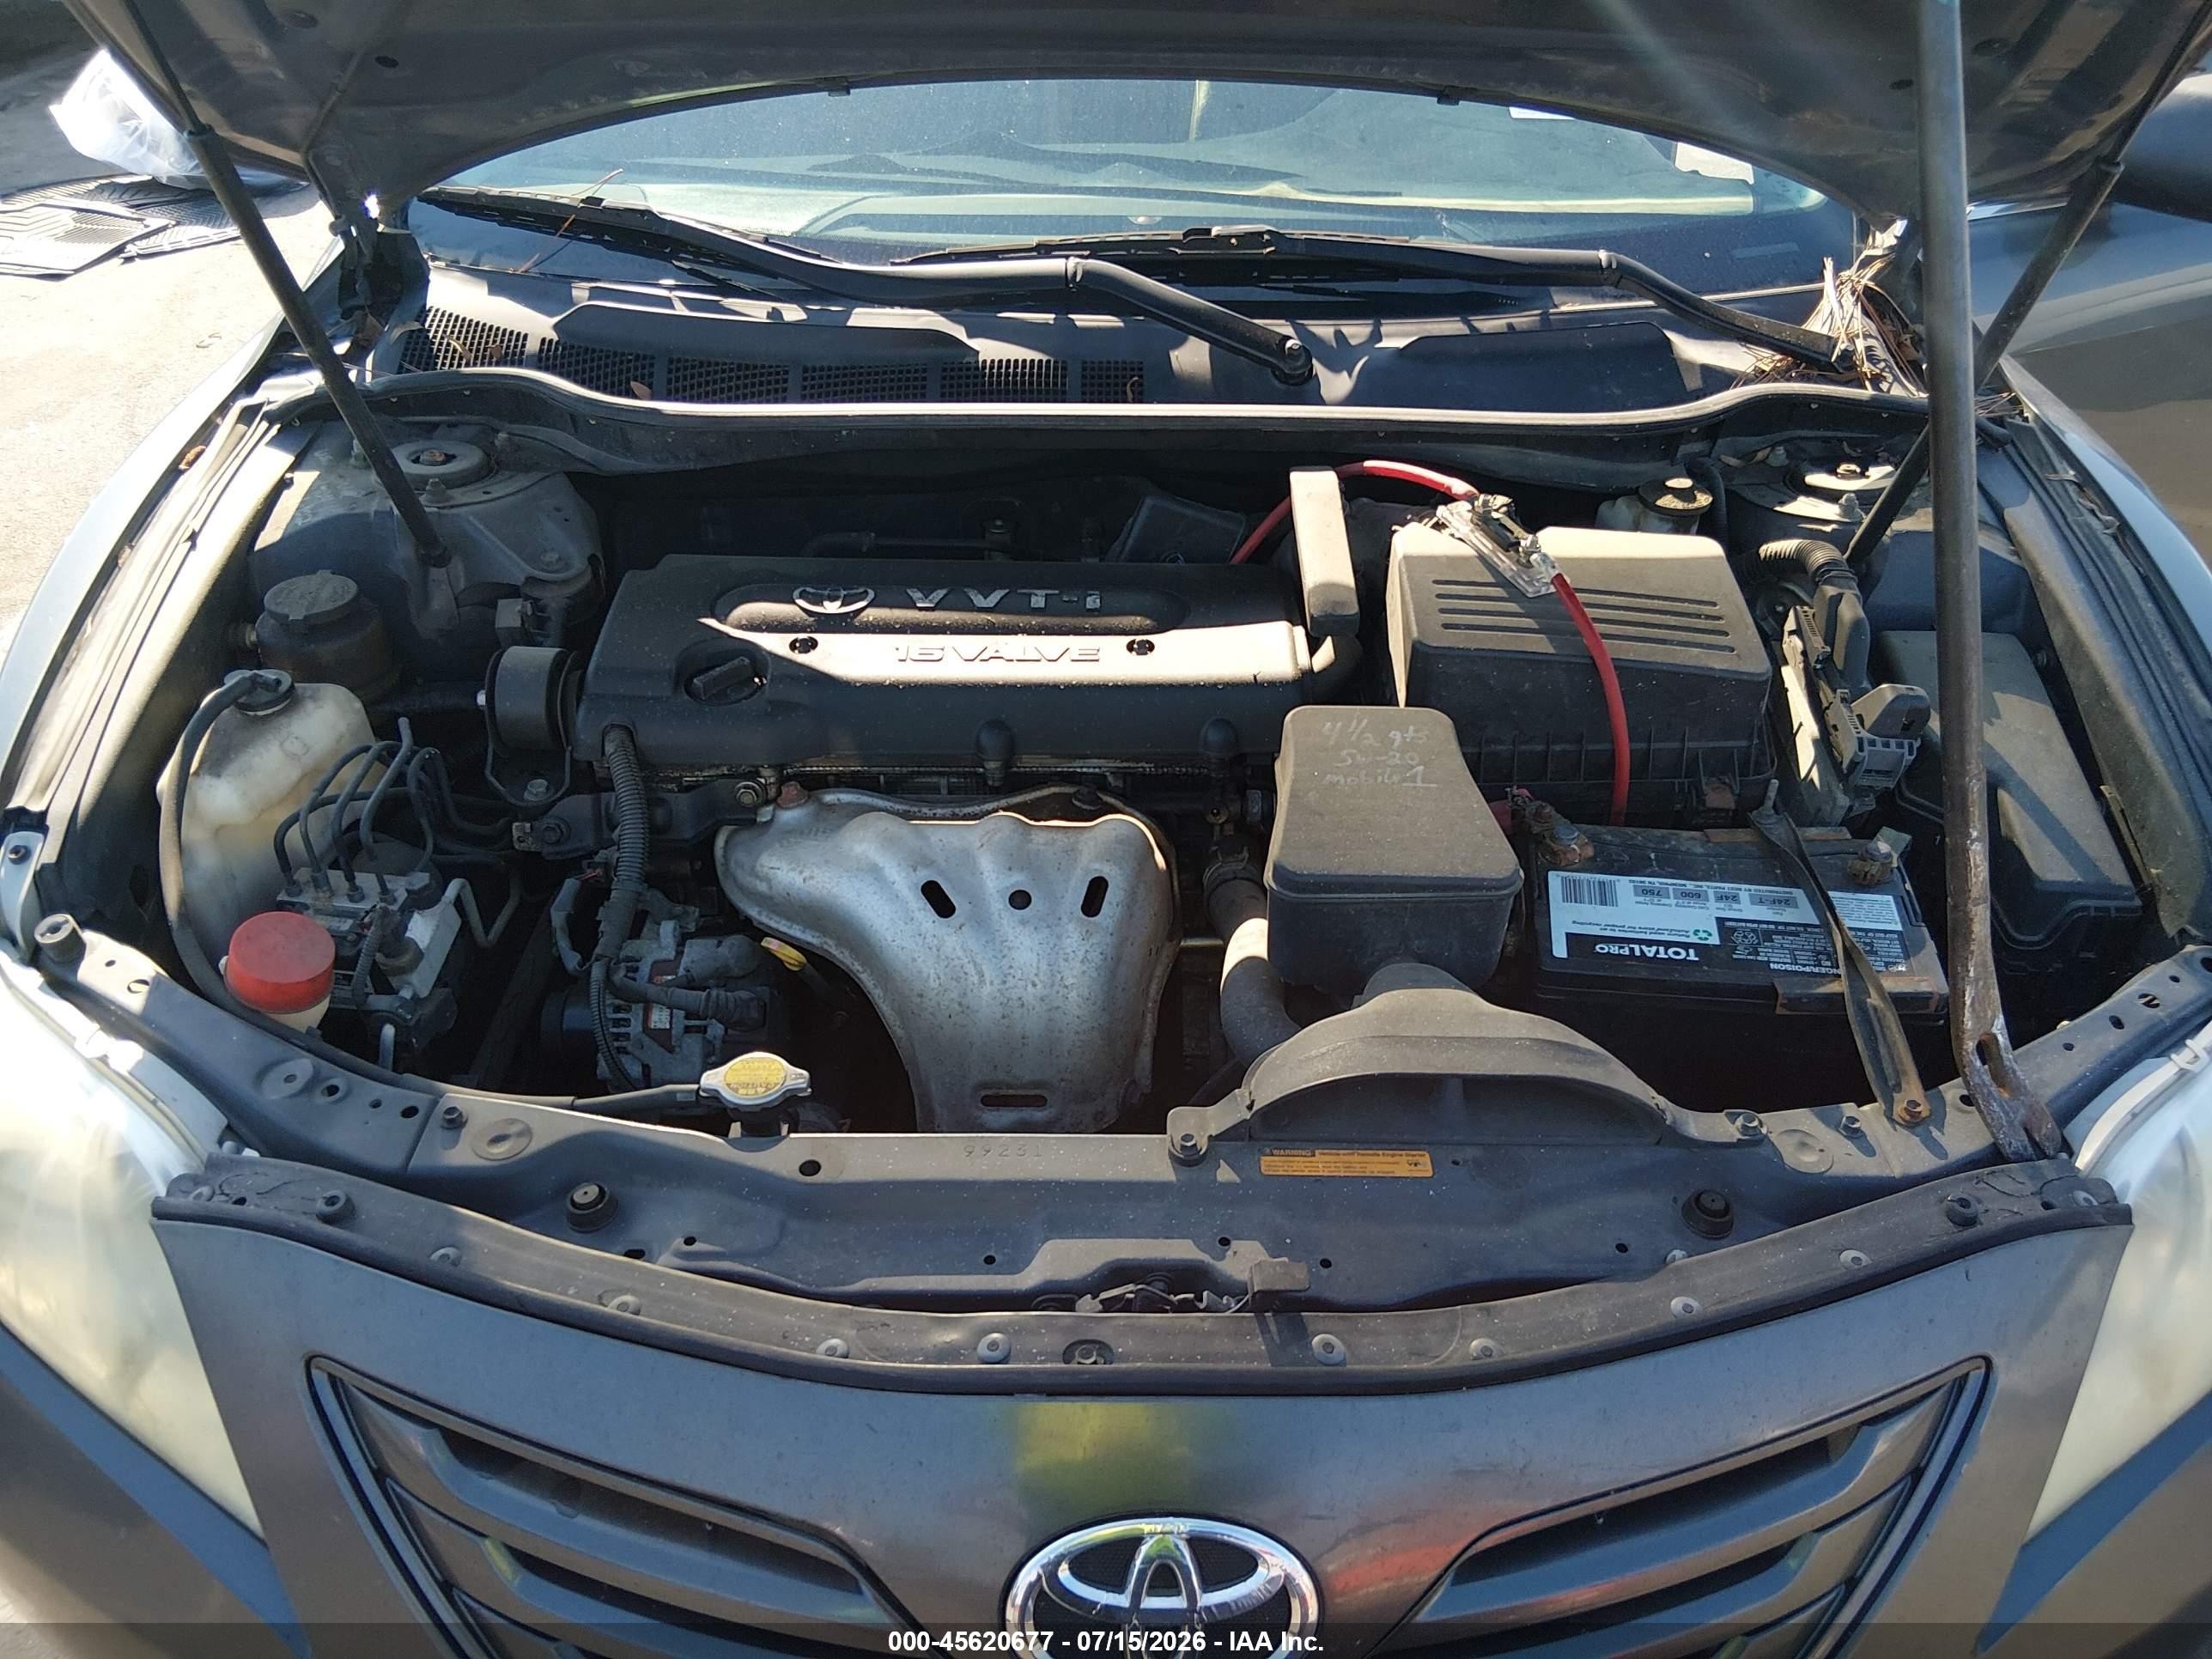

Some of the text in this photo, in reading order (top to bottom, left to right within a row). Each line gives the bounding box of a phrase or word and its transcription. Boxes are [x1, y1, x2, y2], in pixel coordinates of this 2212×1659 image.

[1322, 721, 1342, 745] 4
[1641, 889, 1663, 897] 750
[1680, 890, 1702, 899] 600
[1758, 897, 1792, 906] 24F-T
[1595, 943, 1699, 962] TOTALPRO
